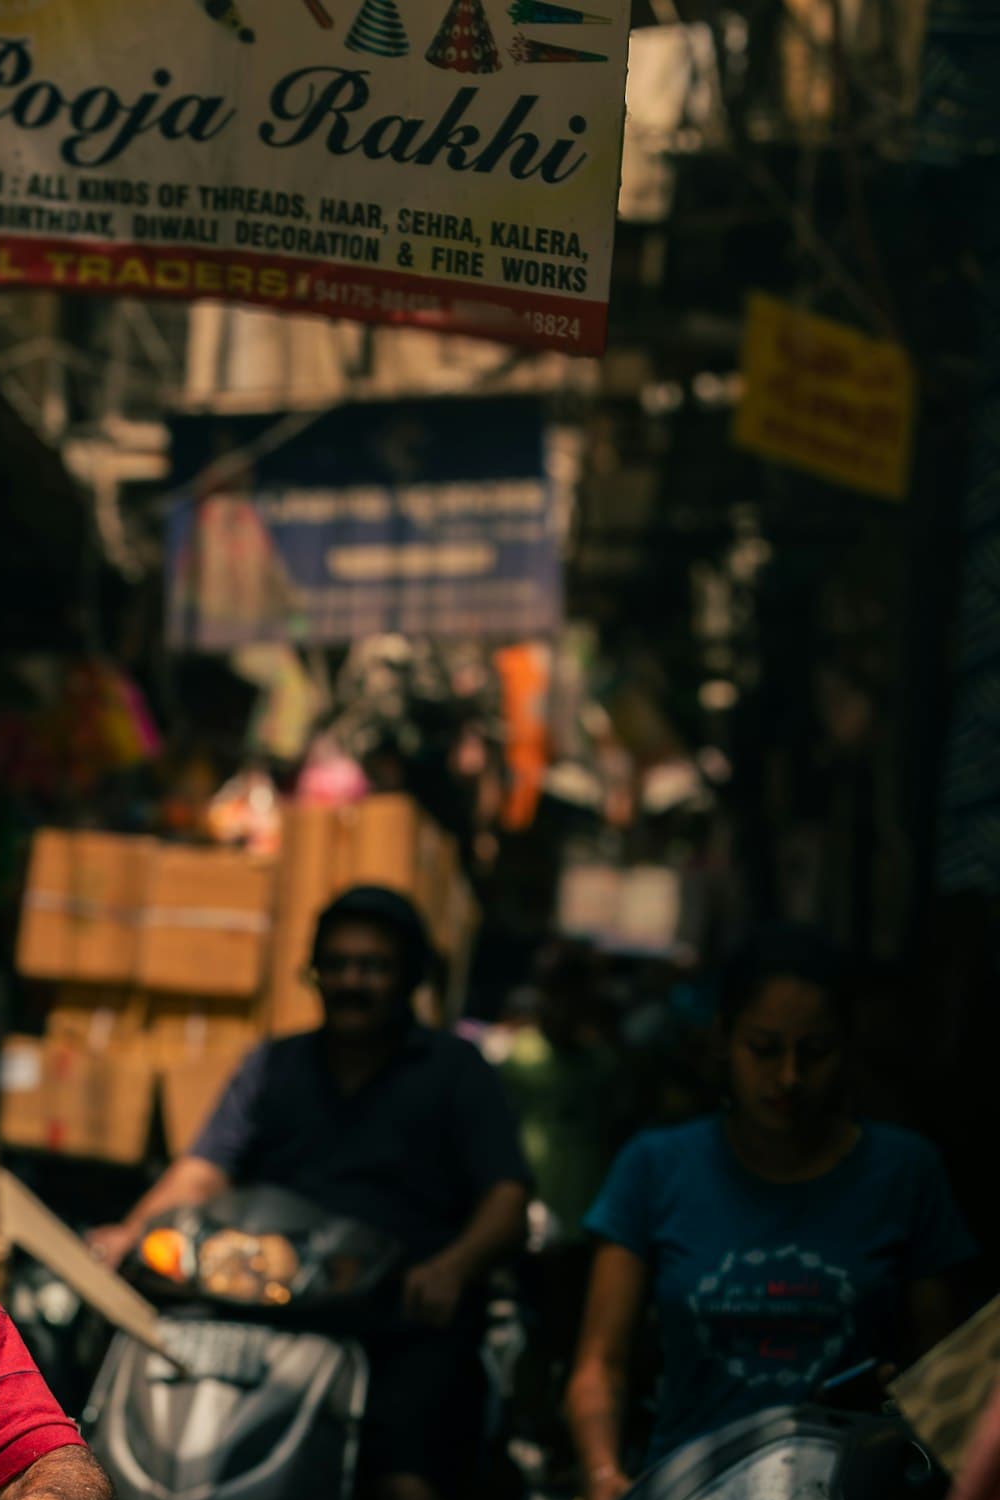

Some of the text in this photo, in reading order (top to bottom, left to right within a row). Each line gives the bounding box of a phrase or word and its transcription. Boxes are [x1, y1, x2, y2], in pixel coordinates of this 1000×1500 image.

[259, 66, 587, 184] Rakhi
[28, 174, 67, 201] ALL
[77, 177, 148, 206] KINDS
[158, 184, 190, 208] OF
[199, 187, 310, 223] THREADS,
[320, 198, 388, 234] HAAR,
[397, 208, 481, 246] SEHRA,
[491, 221, 588, 262] KALERA,
[132, 215, 217, 243] DIWALI
[236, 220, 379, 262] DECORATION
[397, 241, 414, 268] &
[432, 247, 484, 278] FIRE
[502, 256, 587, 293] WORKS
[44, 251, 288, 298] TRADERS
